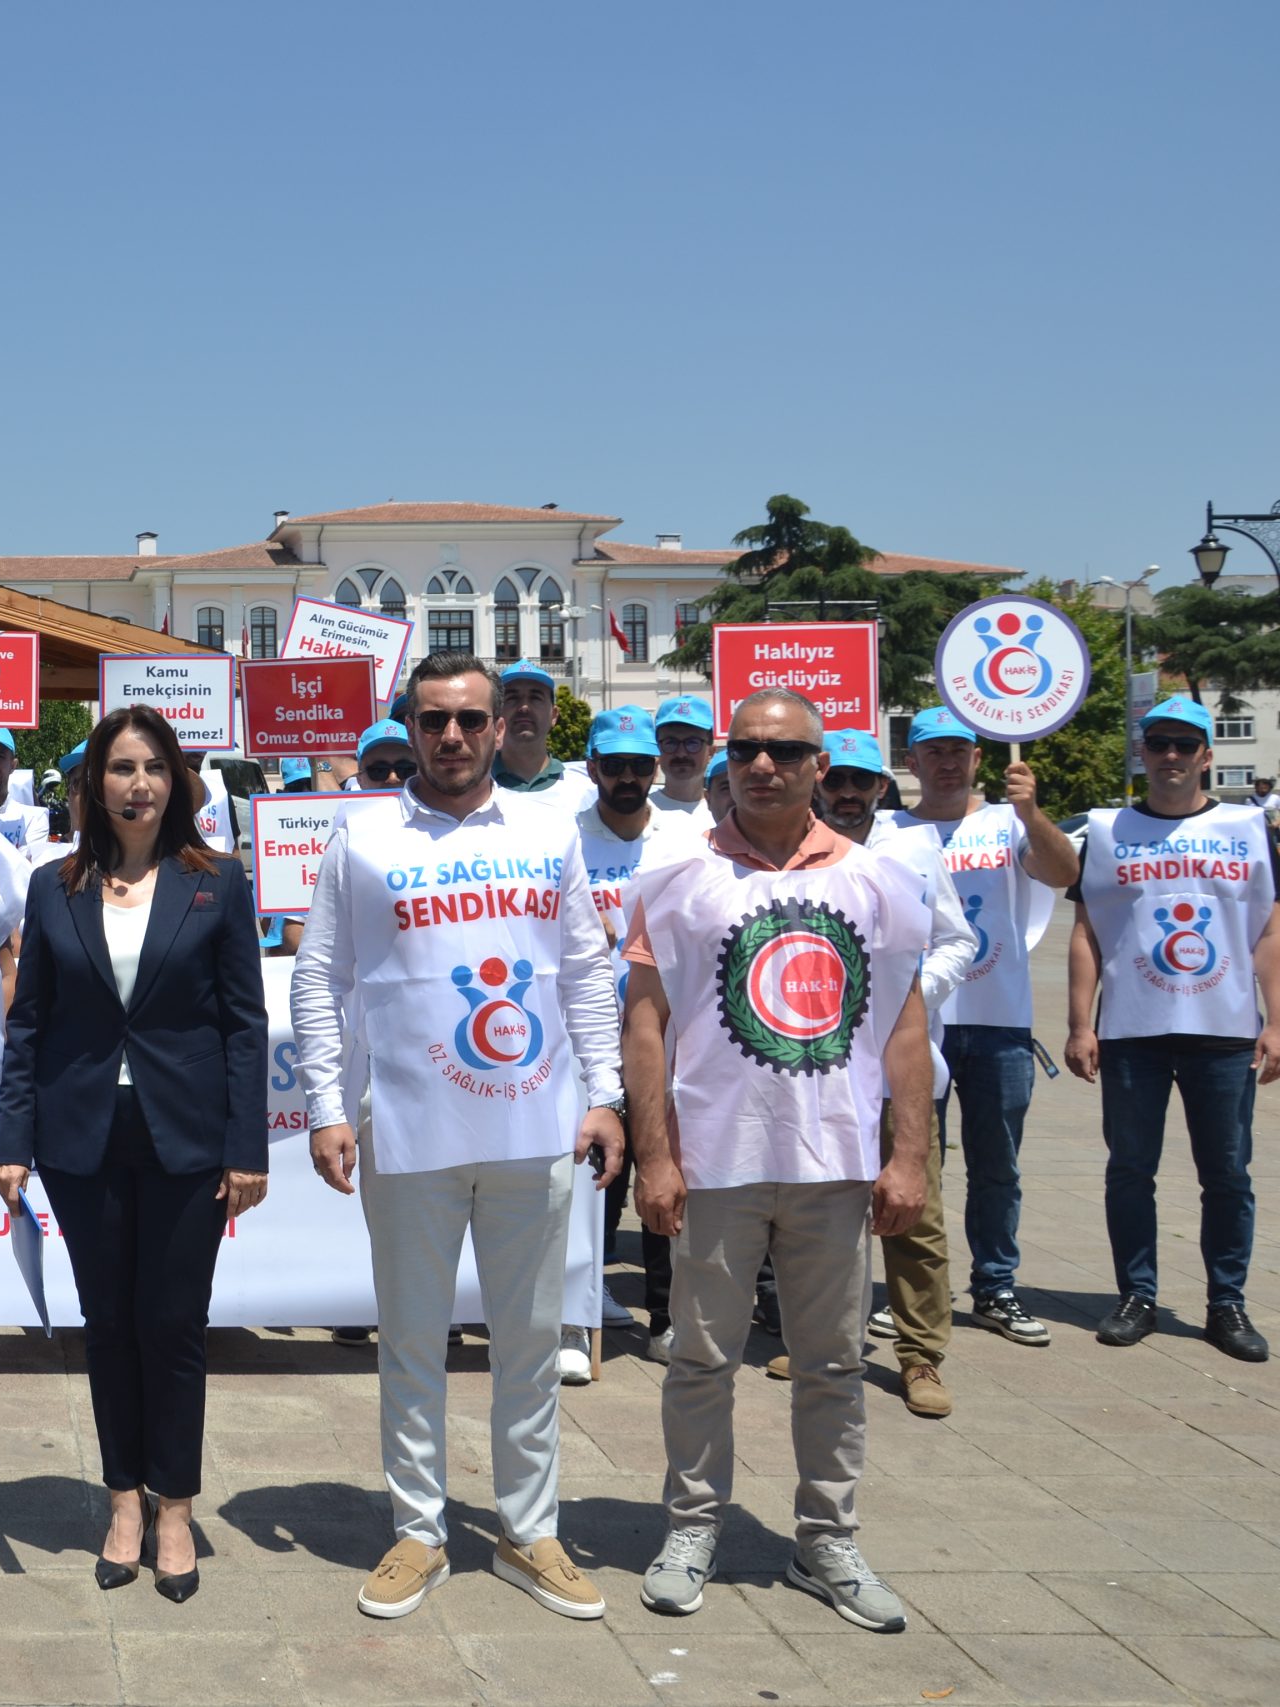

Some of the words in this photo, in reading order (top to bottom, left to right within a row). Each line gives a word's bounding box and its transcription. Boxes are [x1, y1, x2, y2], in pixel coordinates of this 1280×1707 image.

[309, 613, 335, 627] Alım
[337, 619, 389, 640] Gücümüz
[320, 628, 370, 649] Erimesin,
[754, 642, 835, 663] Haklıyız
[146, 666, 189, 678] Kamu
[748, 670, 842, 690] Güçlüyüz
[123, 684, 212, 699] Emekçisinin
[290, 673, 323, 699] İşçi
[951, 675, 968, 692] ÖZ
[1027, 669, 1075, 720] SENDİKASI
[275, 704, 344, 721] Sendika
[256, 731, 300, 745] Omuz
[278, 816, 330, 832] Türkiye
[1114, 840, 1142, 860] ÖZ
[1148, 835, 1249, 861] SAĞLIK-İŞ
[386, 863, 428, 892] ÖZ
[436, 851, 563, 888] SAĞLIK-İŞ
[1116, 855, 1249, 886] SENDİKASI
[394, 883, 561, 931] SENDİKASI
[494, 1021, 527, 1037] HAK-İŞ
[428, 1042, 448, 1064] ÖZ
[442, 1063, 517, 1101] SAĞLIK-İŞ
